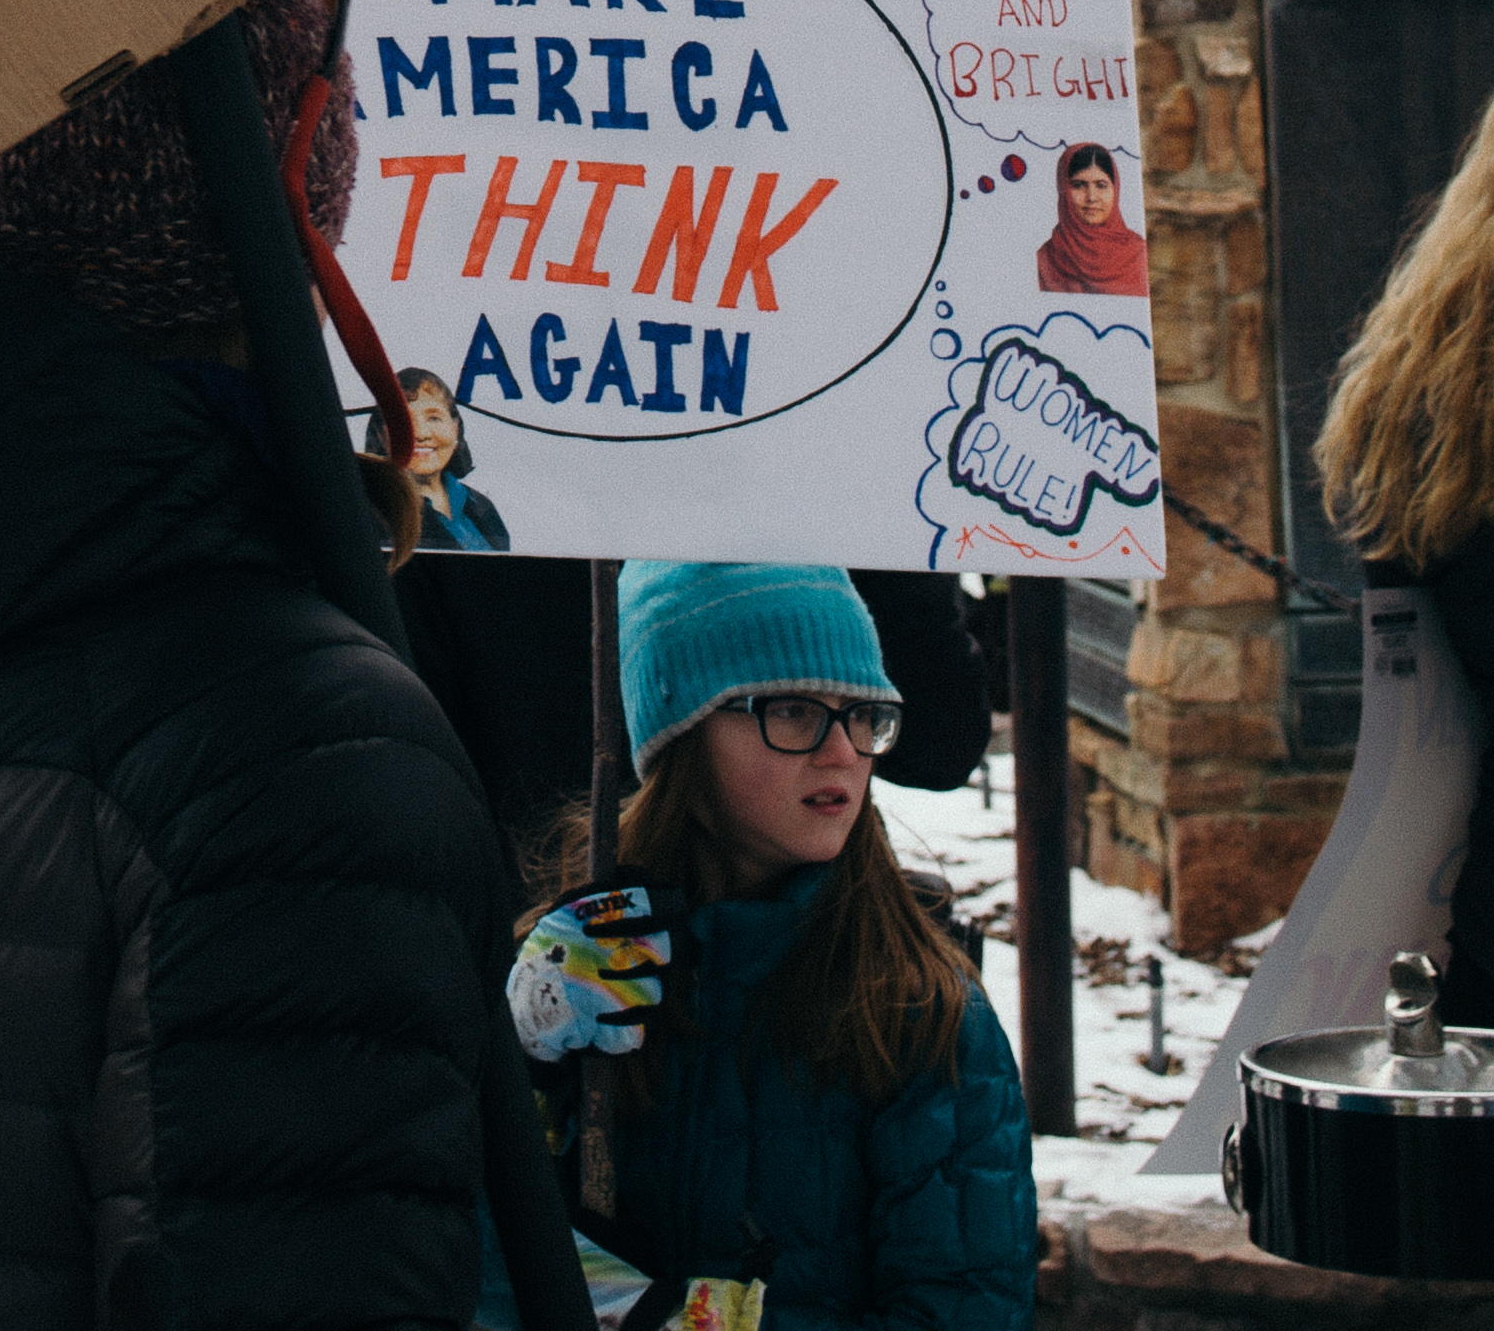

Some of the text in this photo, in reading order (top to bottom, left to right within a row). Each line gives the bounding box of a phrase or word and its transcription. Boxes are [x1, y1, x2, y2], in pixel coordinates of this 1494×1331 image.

[352, 36, 788, 132] MERICA
[949, 42, 1129, 101] BRIGHT
[381, 154, 839, 312] THINK
[456, 313, 751, 416] AGAIN
[995, 354, 1151, 480] WOMEN
[962, 422, 1076, 519] RULE!
